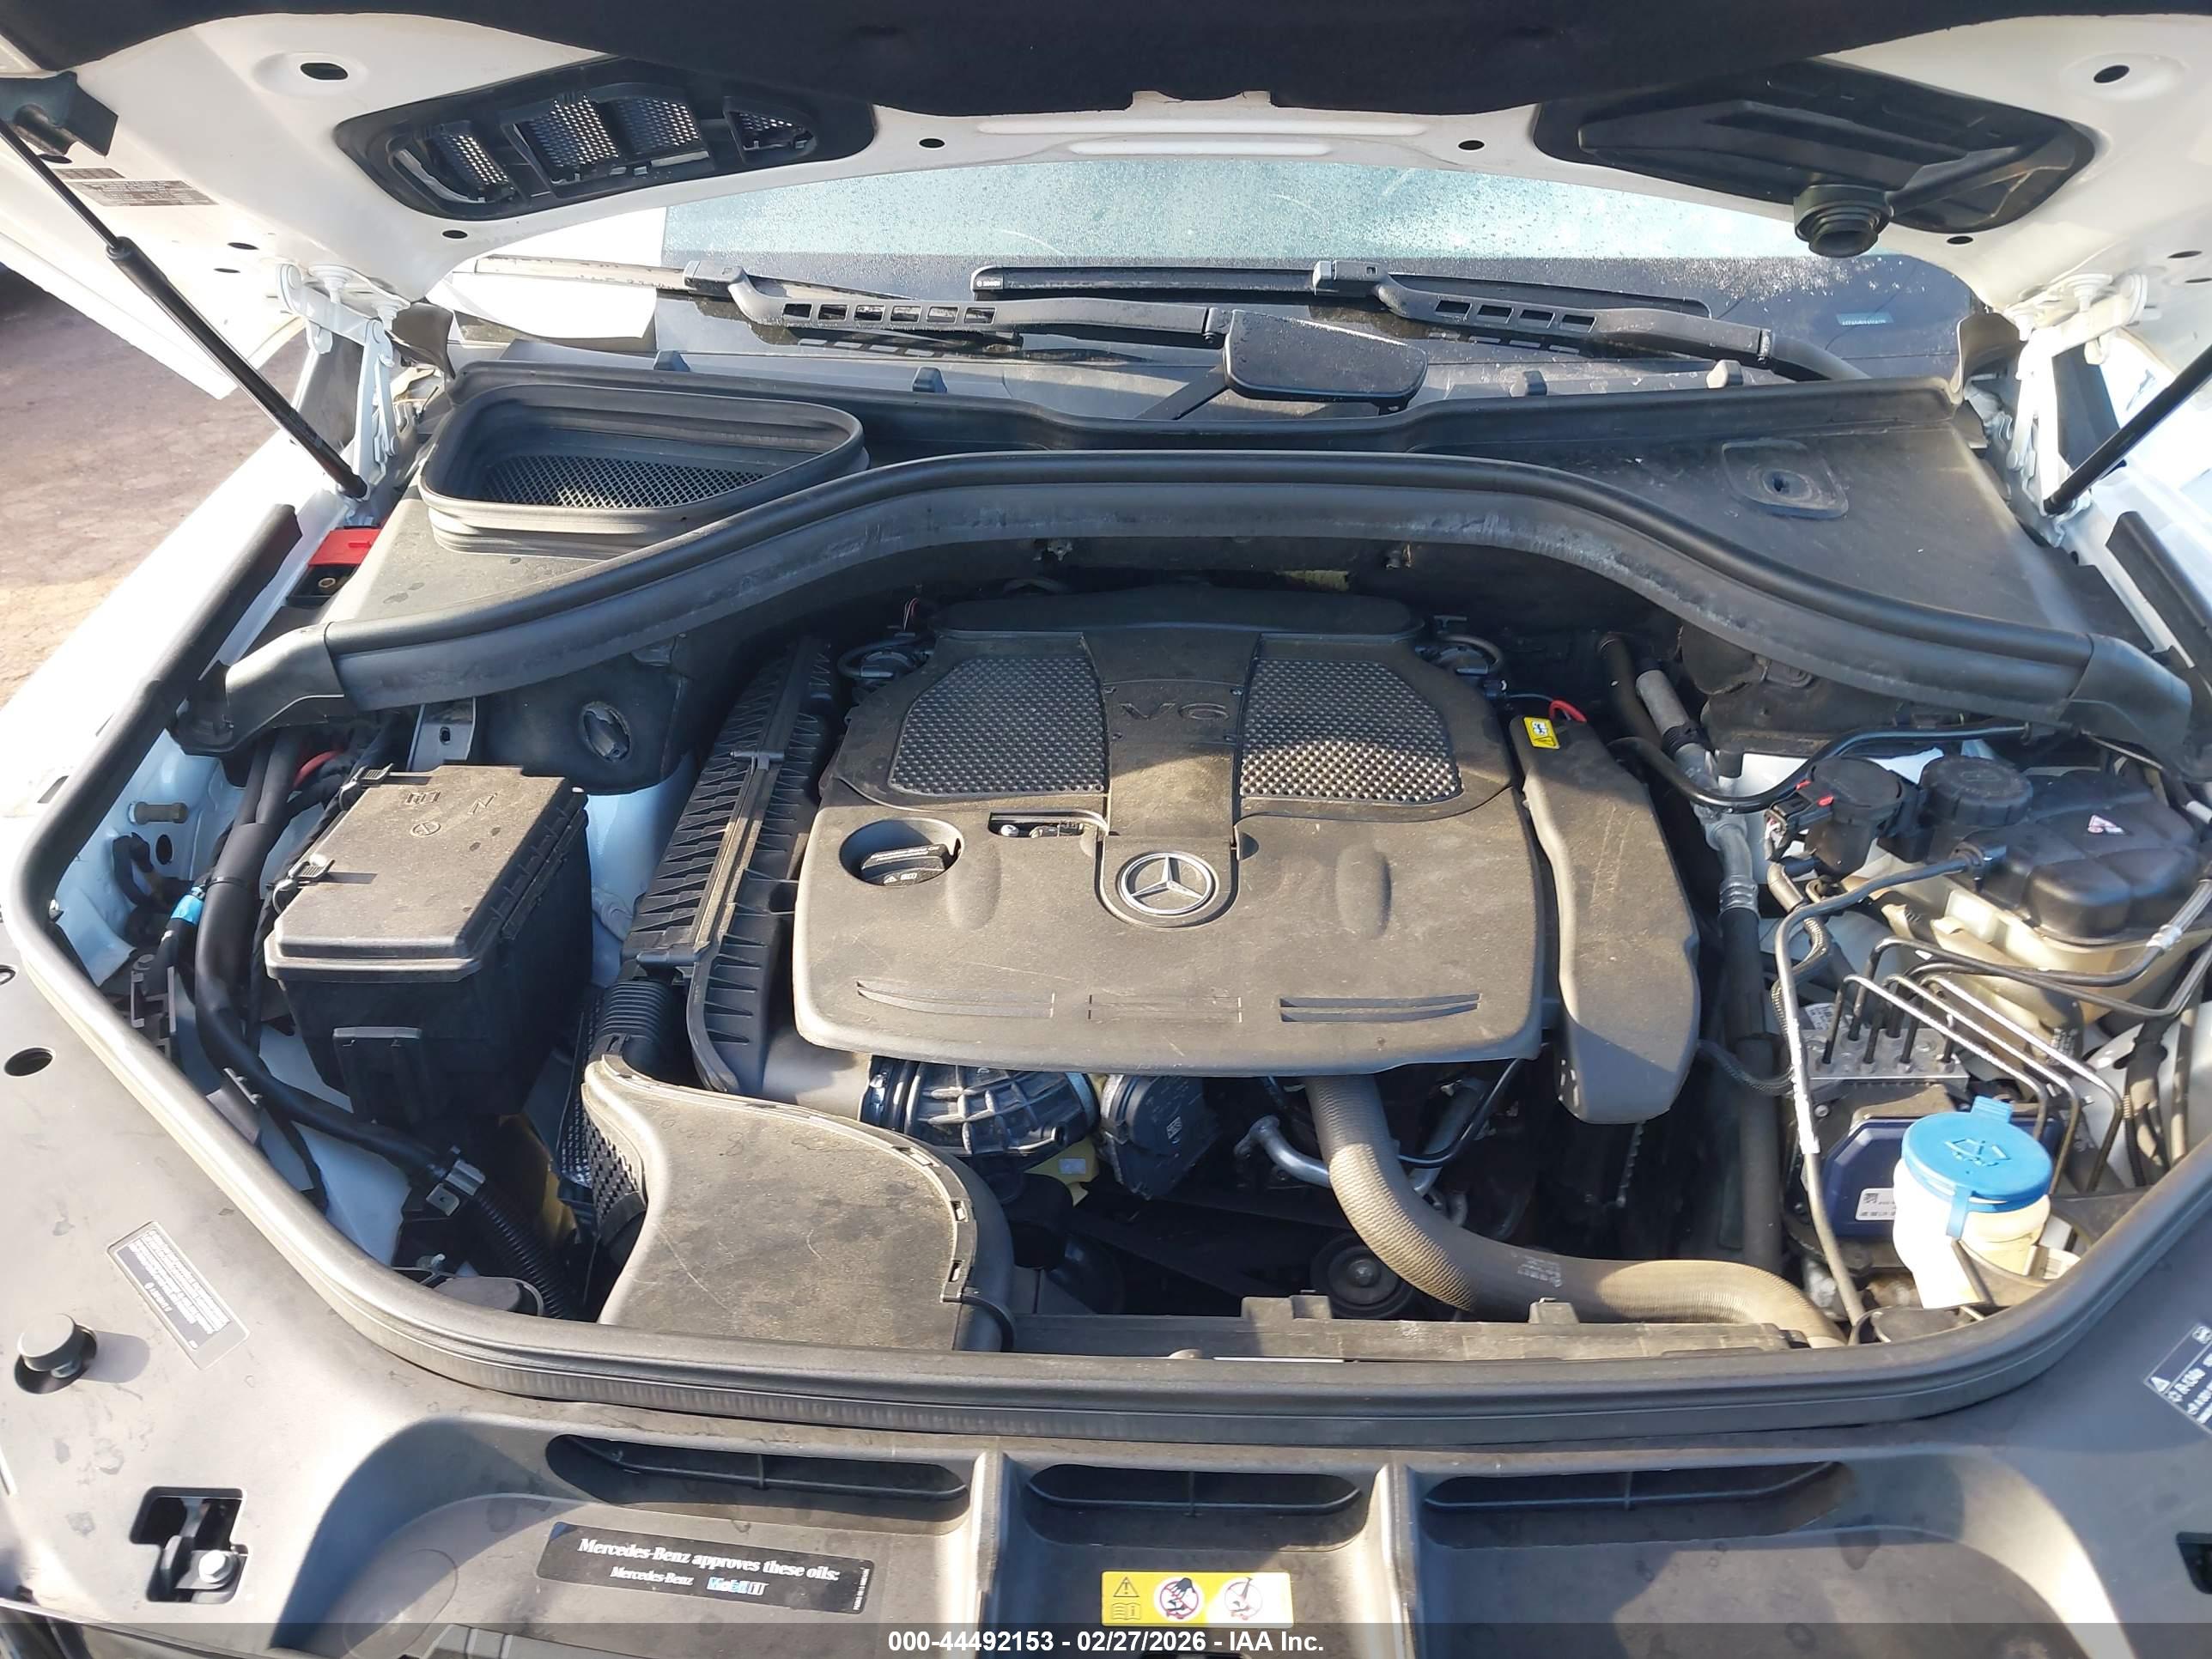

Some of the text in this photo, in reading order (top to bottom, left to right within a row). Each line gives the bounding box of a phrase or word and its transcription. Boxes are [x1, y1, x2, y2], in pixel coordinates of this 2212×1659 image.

[1119, 702, 1230, 721] V6
[577, 1538, 841, 1581] Mercedes-Benz approves these oils:
[610, 1565, 694, 1586] Mercedes-Benz
